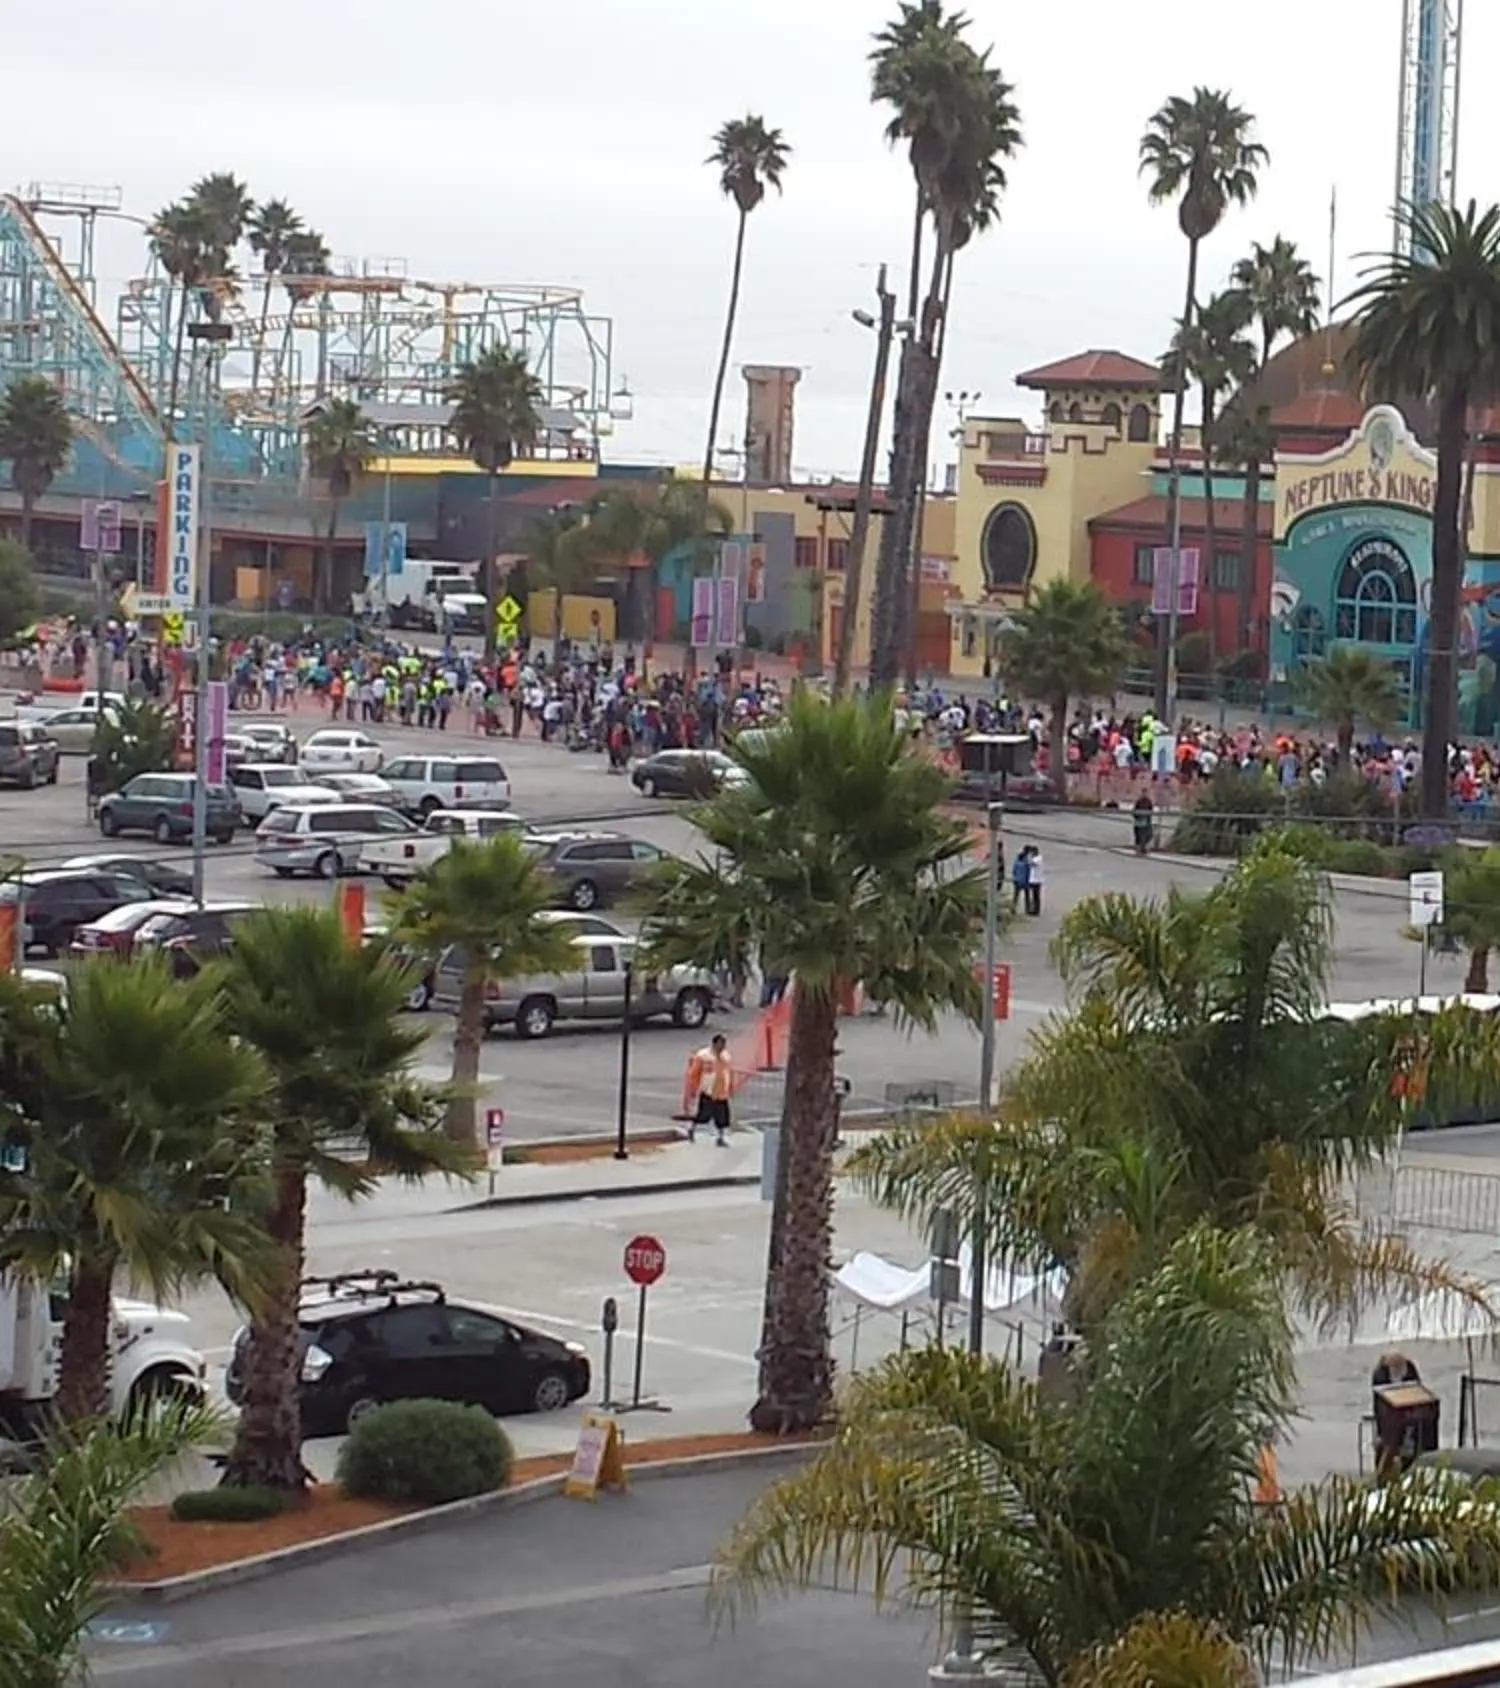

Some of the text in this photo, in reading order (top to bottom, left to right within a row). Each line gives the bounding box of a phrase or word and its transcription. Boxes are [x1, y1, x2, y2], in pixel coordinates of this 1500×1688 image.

[1386, 469, 1438, 508] KING
[173, 452, 193, 596] PARKING
[628, 1248, 663, 1271] STOP
